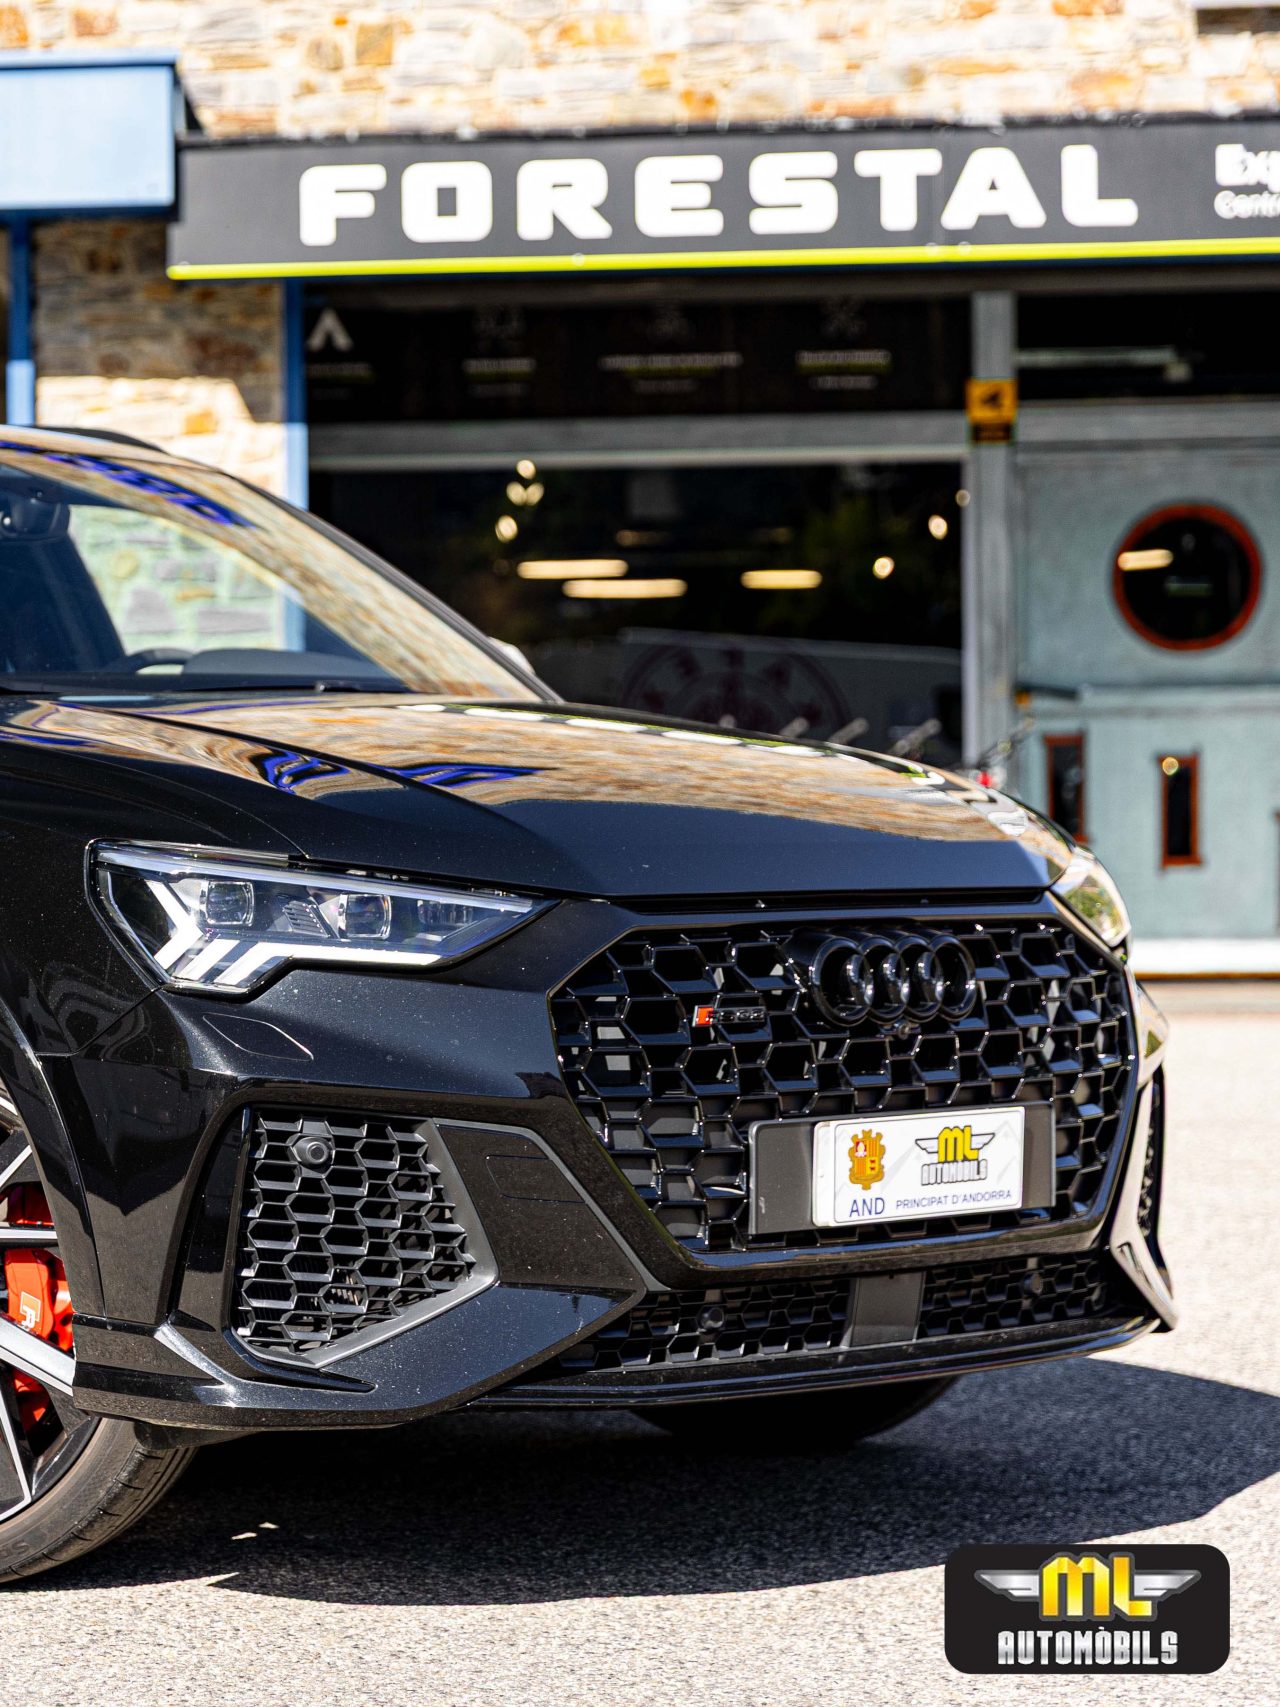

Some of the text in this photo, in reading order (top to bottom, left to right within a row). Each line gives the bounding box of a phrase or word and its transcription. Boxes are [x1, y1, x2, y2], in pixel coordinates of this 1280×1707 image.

[298, 143, 1140, 248] FORESTAL
[937, 1124, 980, 1164] ML
[848, 1189, 1012, 1218] AND PRINCIPAT D'ANDORRA
